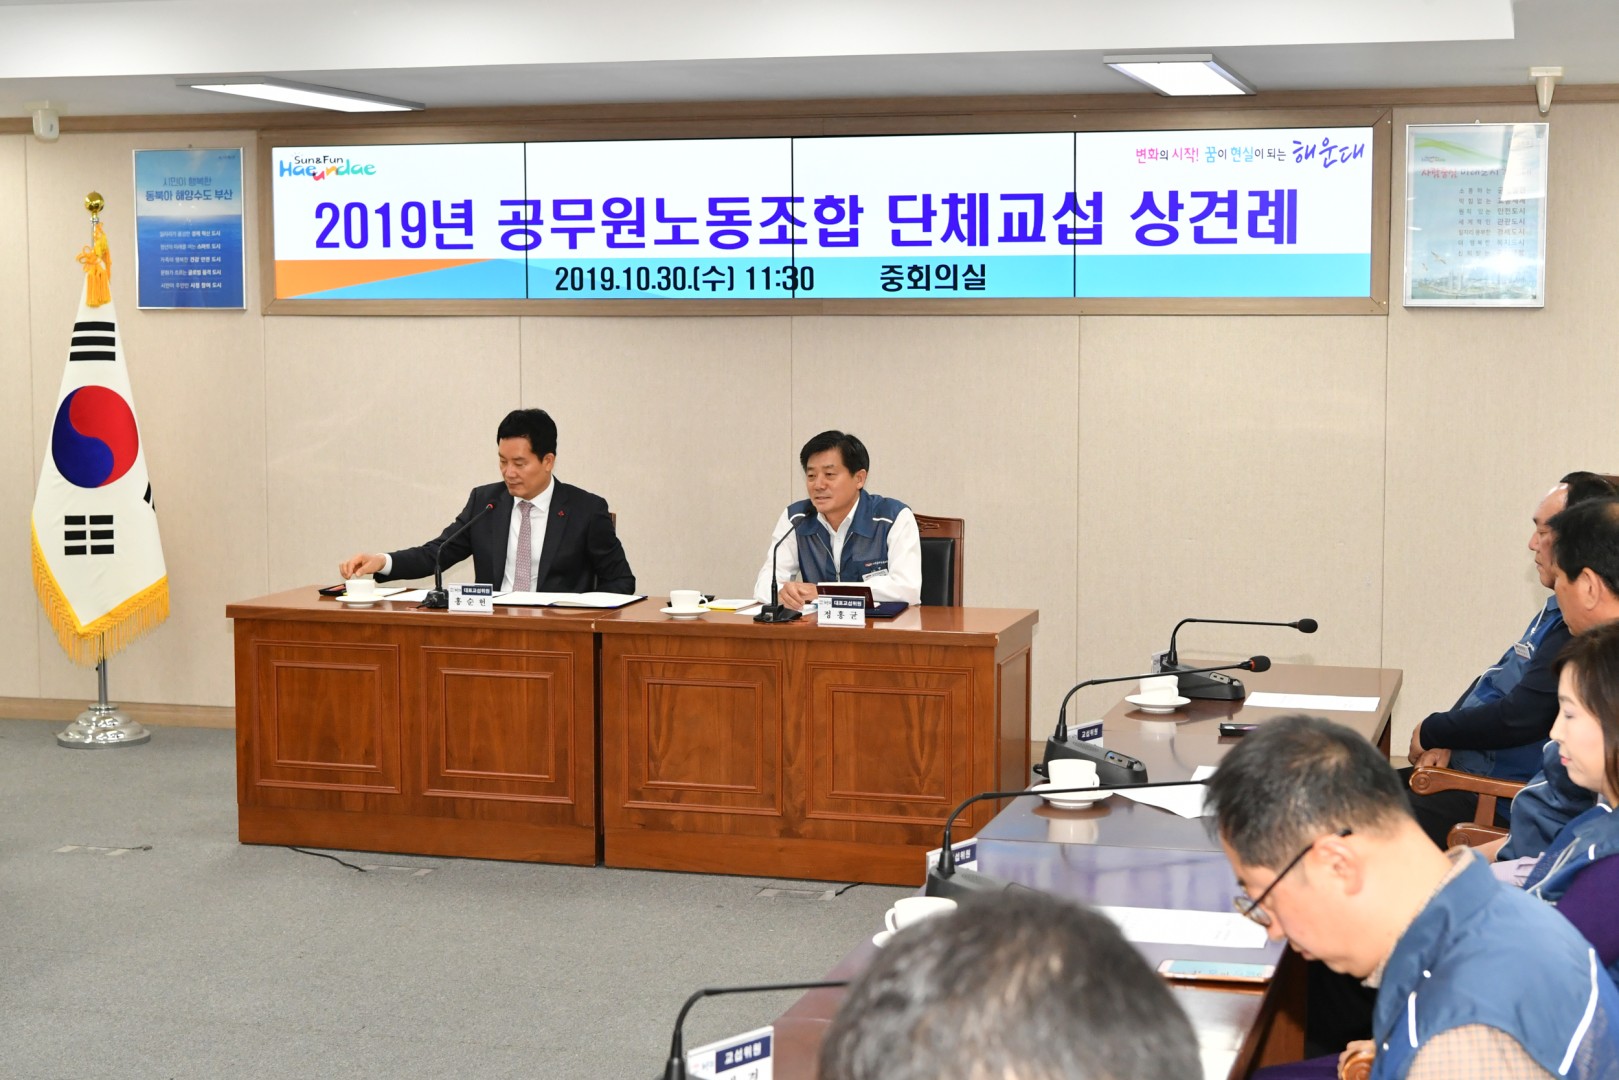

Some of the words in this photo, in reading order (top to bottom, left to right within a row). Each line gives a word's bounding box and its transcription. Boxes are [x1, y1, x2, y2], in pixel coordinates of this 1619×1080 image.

[294, 155, 344, 165] Sun&Fun
[1136, 147, 1169, 164] 변화의
[1172, 147, 1199, 163] 시작!
[1204, 146, 1228, 163] 꿈이
[1230, 146, 1264, 163] 현실이
[1266, 148, 1287, 162] 되는
[1292, 137, 1365, 168] 해운대
[279, 159, 377, 181] Haeundae
[163, 177, 186, 187] 시민이
[145, 191, 173, 201] 동북아
[175, 190, 213, 201] 해양수도
[214, 189, 233, 200] 부산
[315, 199, 474, 251] 2019년
[498, 194, 863, 252] 공무원노동조합
[888, 189, 1104, 248] 단체교섭
[1129, 188, 1299, 247] 상견례
[555, 267, 735, 292] 2019.10.30.(수)
[746, 266, 815, 291] 11:30
[879, 264, 987, 292] 중회의실
[953, 848, 971, 863] 섭위원
[724, 1041, 762, 1065] 교섭위원
